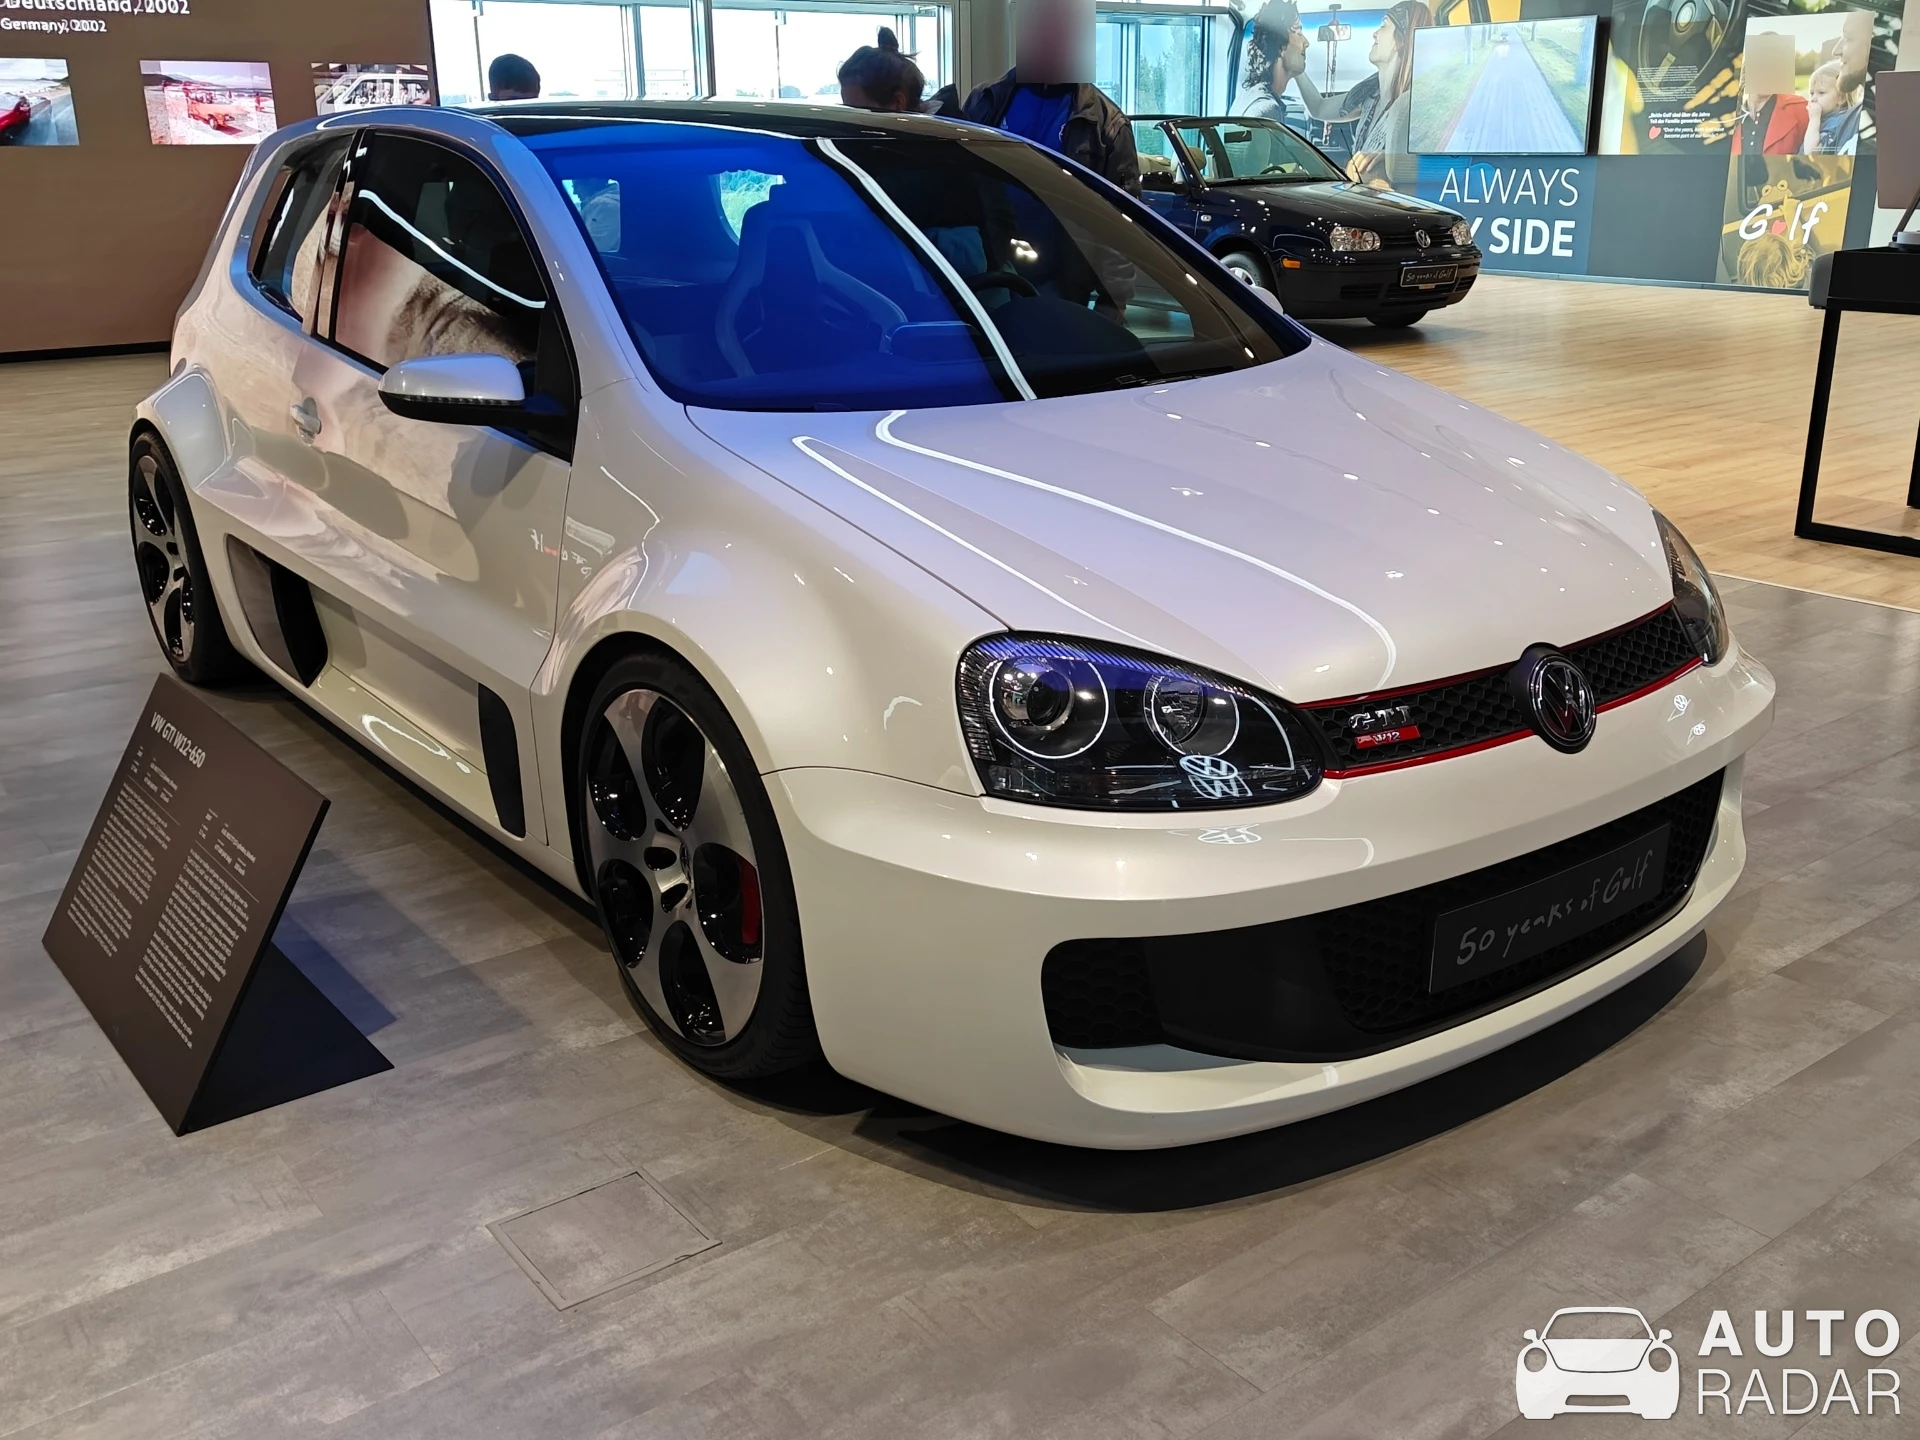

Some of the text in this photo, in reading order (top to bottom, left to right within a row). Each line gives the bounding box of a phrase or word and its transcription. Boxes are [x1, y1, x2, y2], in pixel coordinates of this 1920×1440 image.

[0, 17, 107, 34] Germany, 2002
[146, 0, 190, 14] 2002
[1438, 167, 1580, 207] ALWAYS
[1488, 217, 1576, 257] SIDE
[1348, 705, 1412, 733] GTI
[150, 711, 206, 768] VW GTI W12-650
[1456, 926, 1496, 965] 50
[1580, 878, 1601, 911] of
